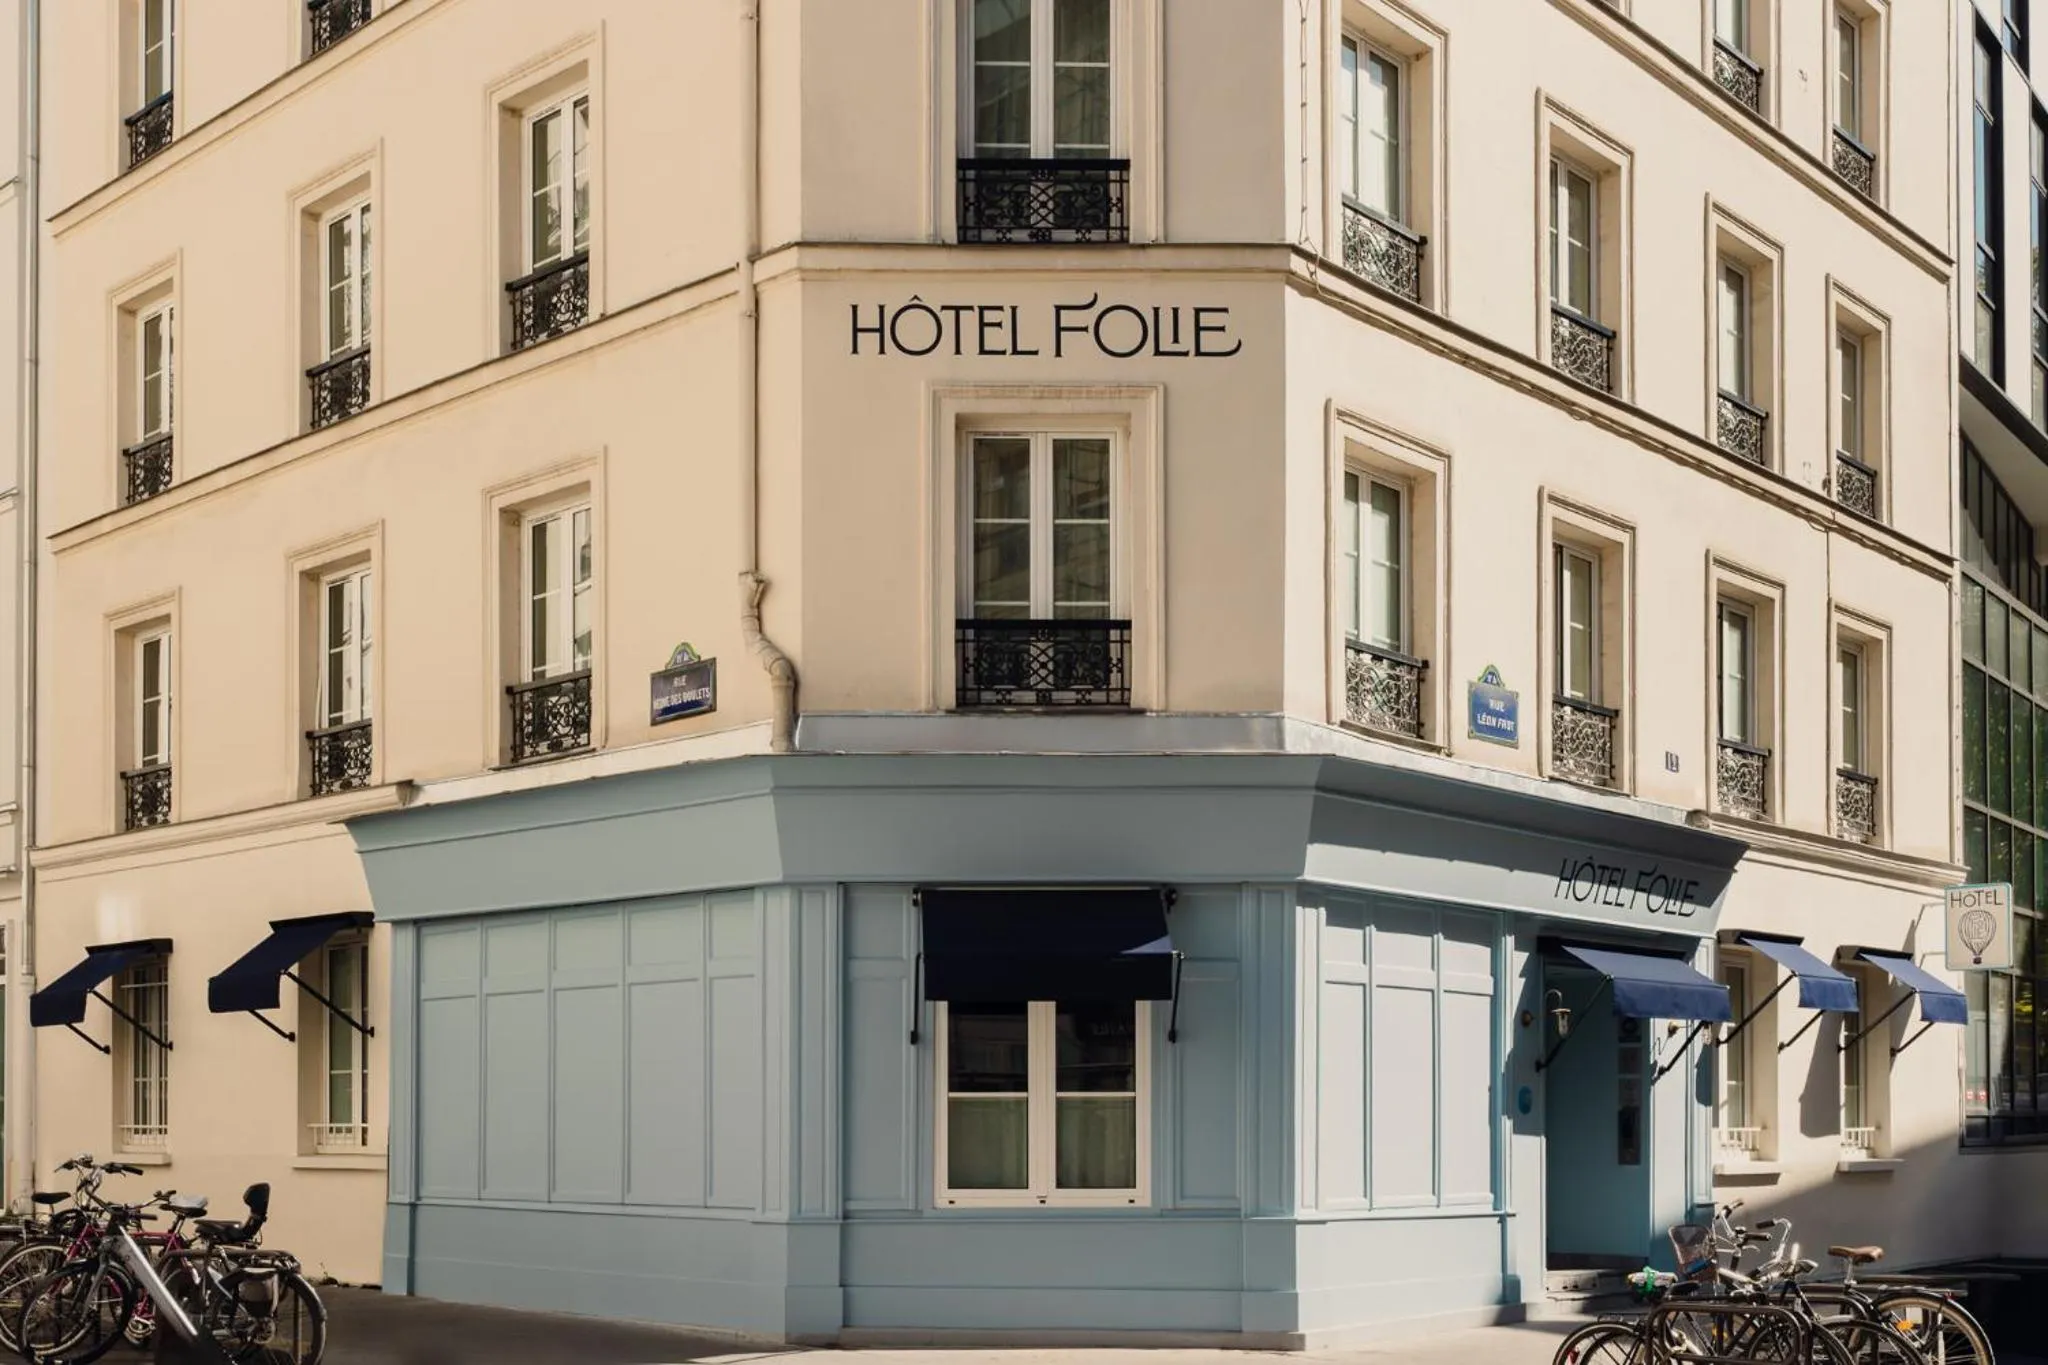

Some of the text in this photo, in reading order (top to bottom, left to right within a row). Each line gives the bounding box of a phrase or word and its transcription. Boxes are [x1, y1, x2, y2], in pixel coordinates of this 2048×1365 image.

[850, 292, 1242, 358] HÔTEL FOLIE
[673, 675, 687, 687] RUE
[1489, 699, 1505, 712] RUE
[1476, 712, 1497, 727] LÉON
[1554, 855, 1700, 917] HÔTEL FOLIE
